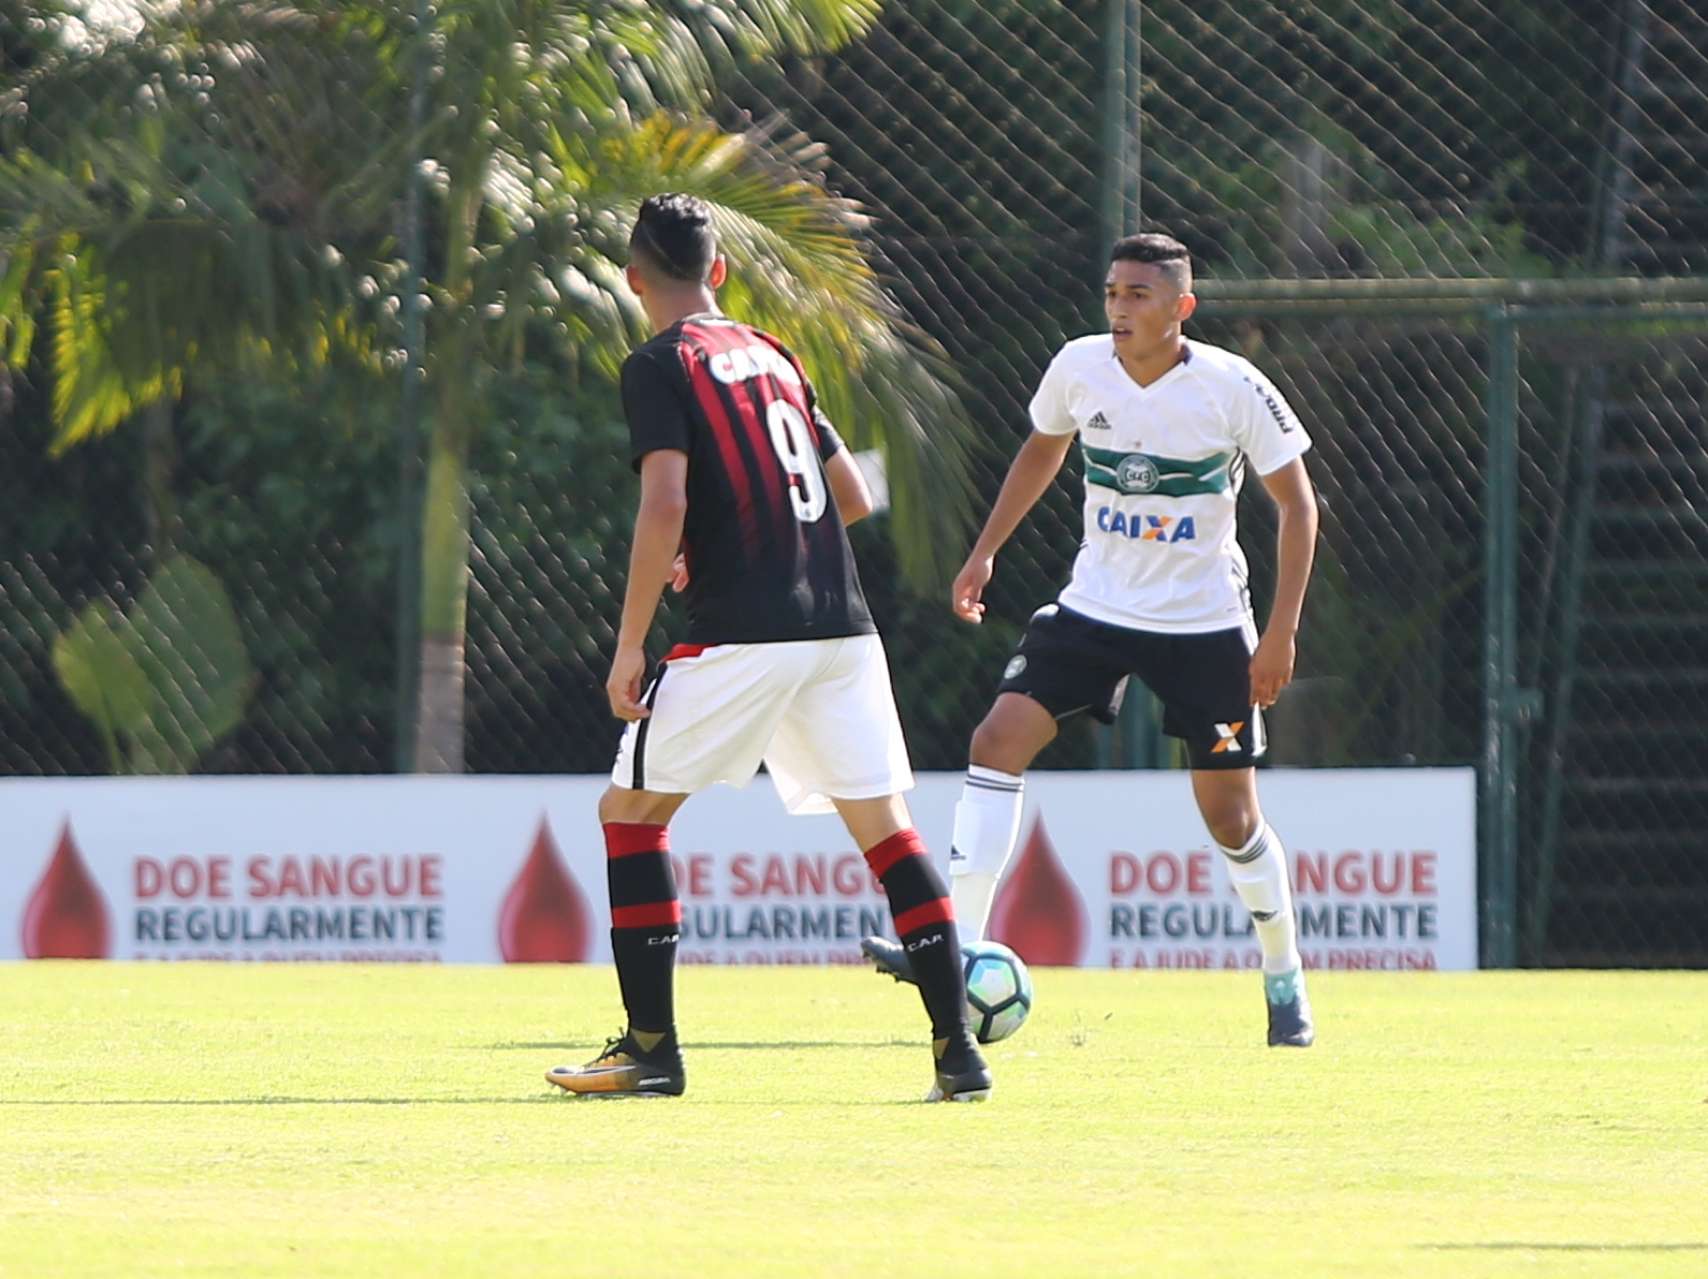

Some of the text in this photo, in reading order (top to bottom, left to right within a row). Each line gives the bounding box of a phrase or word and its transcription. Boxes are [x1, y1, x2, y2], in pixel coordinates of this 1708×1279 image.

[766, 398, 827, 523] 9
[1097, 506, 1196, 544] CAIXA
[134, 854, 443, 899] DOE SANGUE
[731, 854, 887, 897] SANG
[1109, 852, 1438, 895] DOE NGUE
[134, 906, 444, 941] REGULARMENTE
[1109, 903, 1439, 938] REGULMENTE
